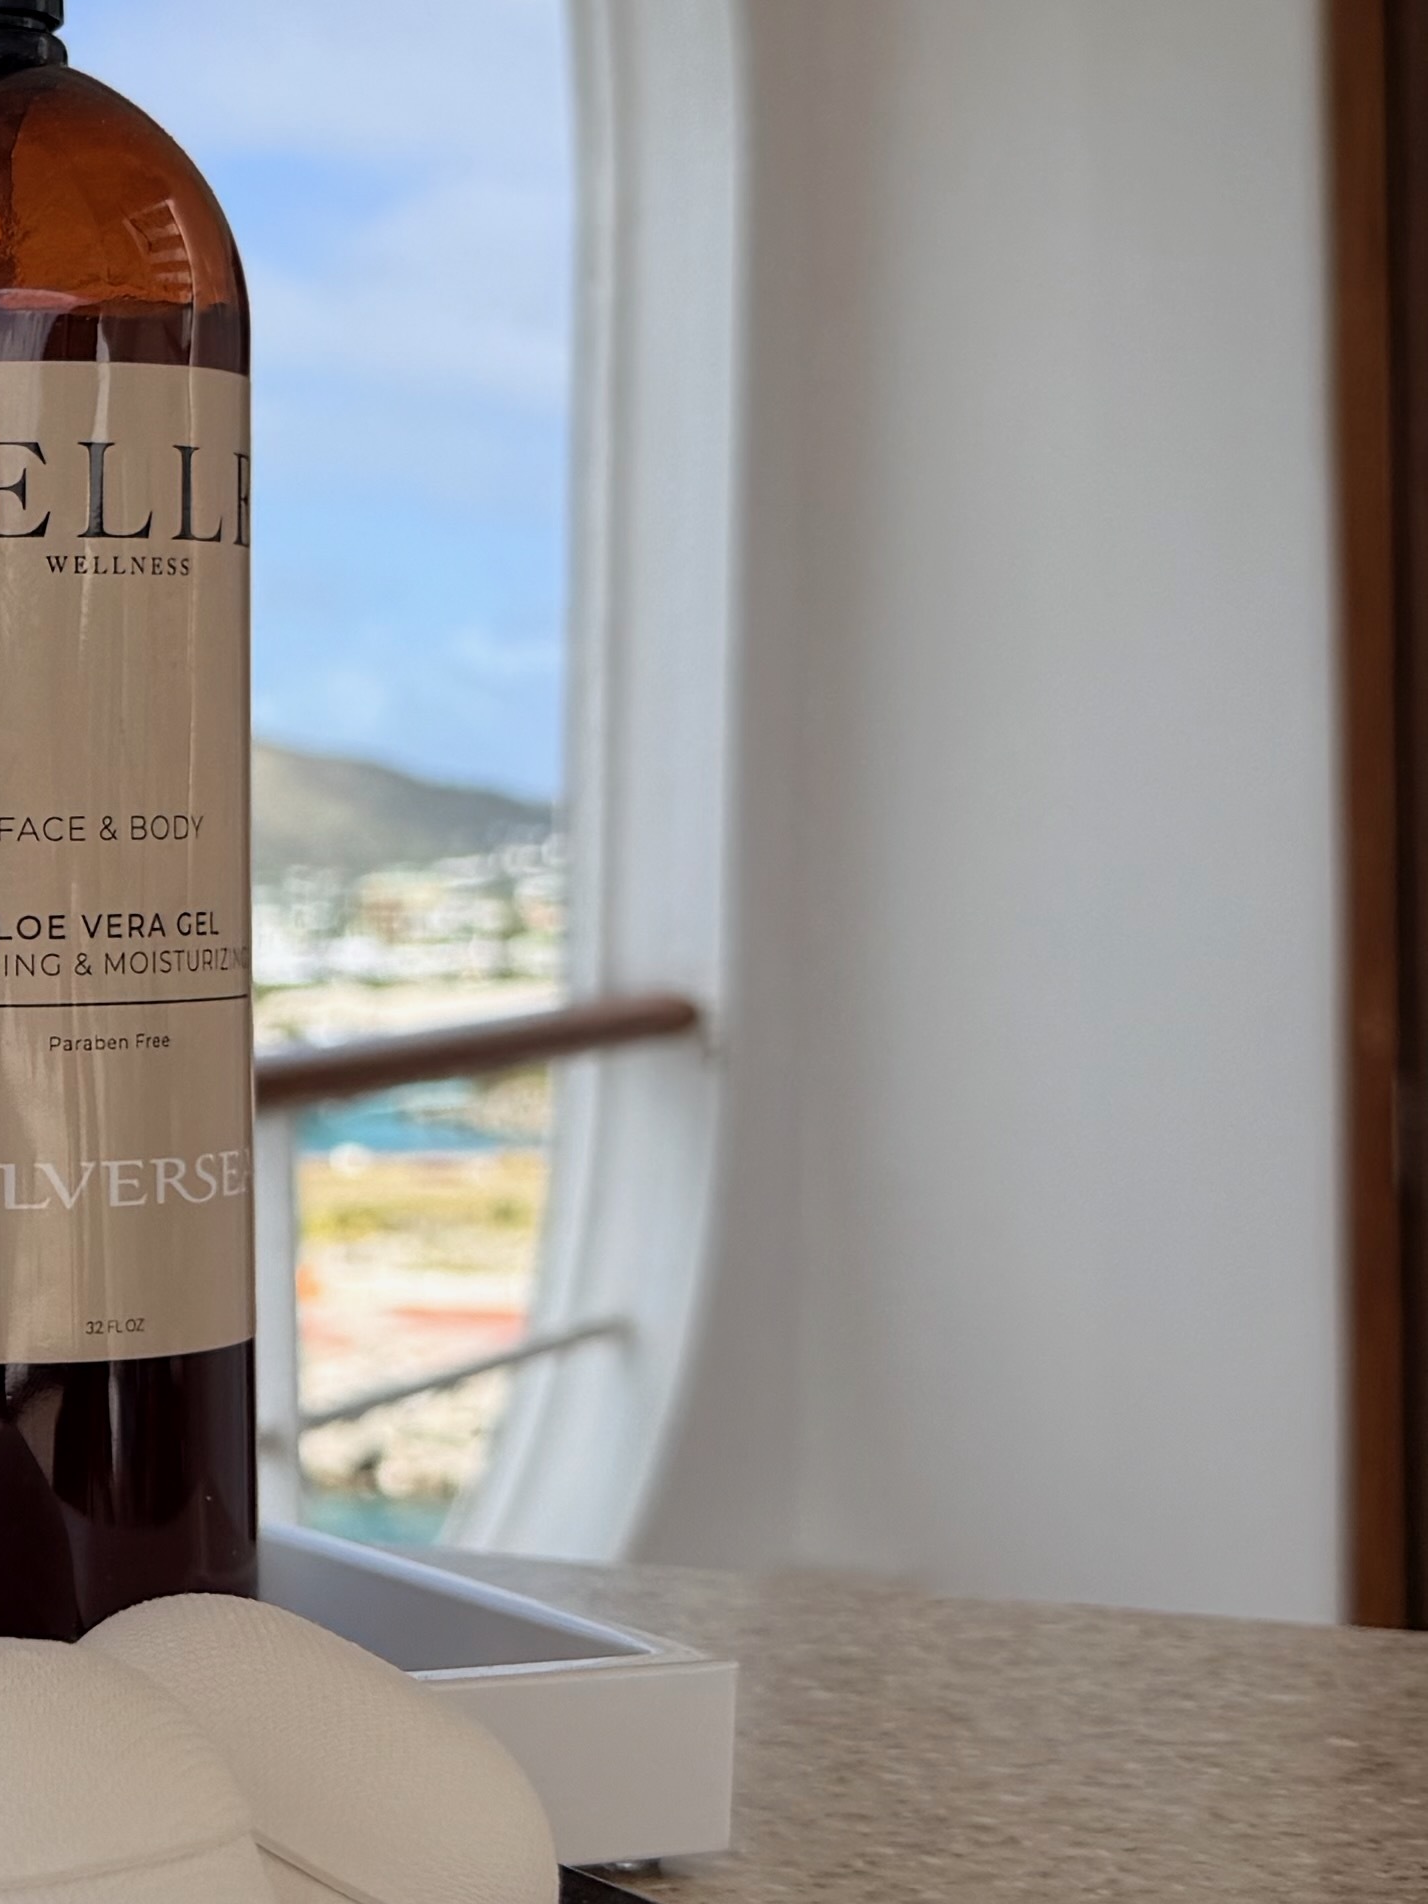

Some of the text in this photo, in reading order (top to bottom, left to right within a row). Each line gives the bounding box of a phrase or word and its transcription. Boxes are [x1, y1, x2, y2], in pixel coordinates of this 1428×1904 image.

[45, 554, 190, 577] WELLNESS
[99, 815, 118, 842] &
[130, 814, 204, 841] BODY
[80, 912, 167, 940] VERA
[176, 911, 220, 937] GEL
[73, 951, 93, 977] &
[49, 1032, 171, 1052] Paraben Free
[85, 1318, 145, 1335] 32 FL OZ
